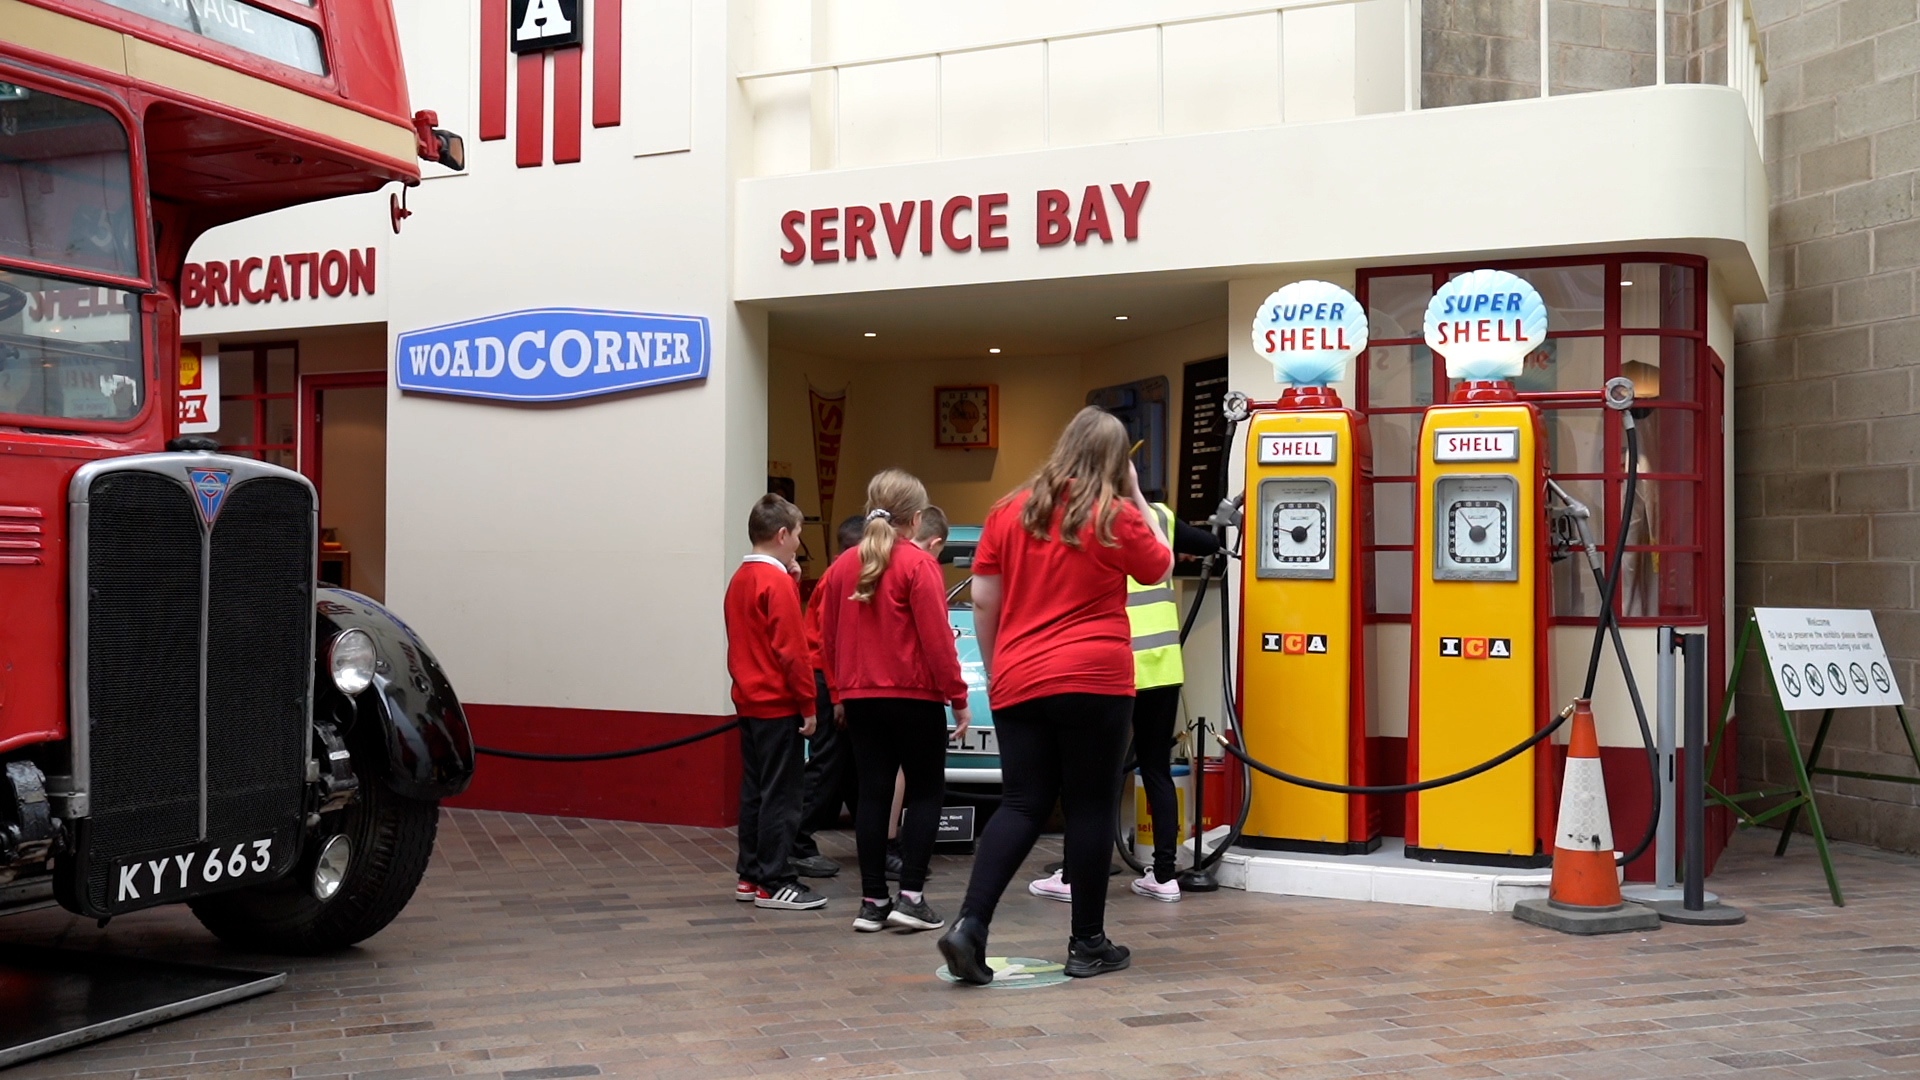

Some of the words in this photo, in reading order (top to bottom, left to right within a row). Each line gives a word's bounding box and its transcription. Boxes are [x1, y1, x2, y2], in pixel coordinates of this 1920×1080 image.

[517, 0, 571, 41] A
[780, 192, 1009, 266] SERVICE
[1036, 180, 1150, 248] BAY
[1270, 302, 1345, 323] SUPER
[1443, 292, 1523, 315] SUPER
[1265, 327, 1351, 354] SHELL
[1437, 318, 1530, 346] SHELL
[817, 402, 843, 504] SHELL
[1272, 441, 1322, 456] SHELL
[1448, 437, 1502, 452] SHELL
[1806, 617, 1831, 627] Welcome
[1263, 633, 1327, 653] ICA
[1441, 638, 1510, 657] ICA
[118, 851, 196, 902] KYY
[202, 838, 272, 883] 663
